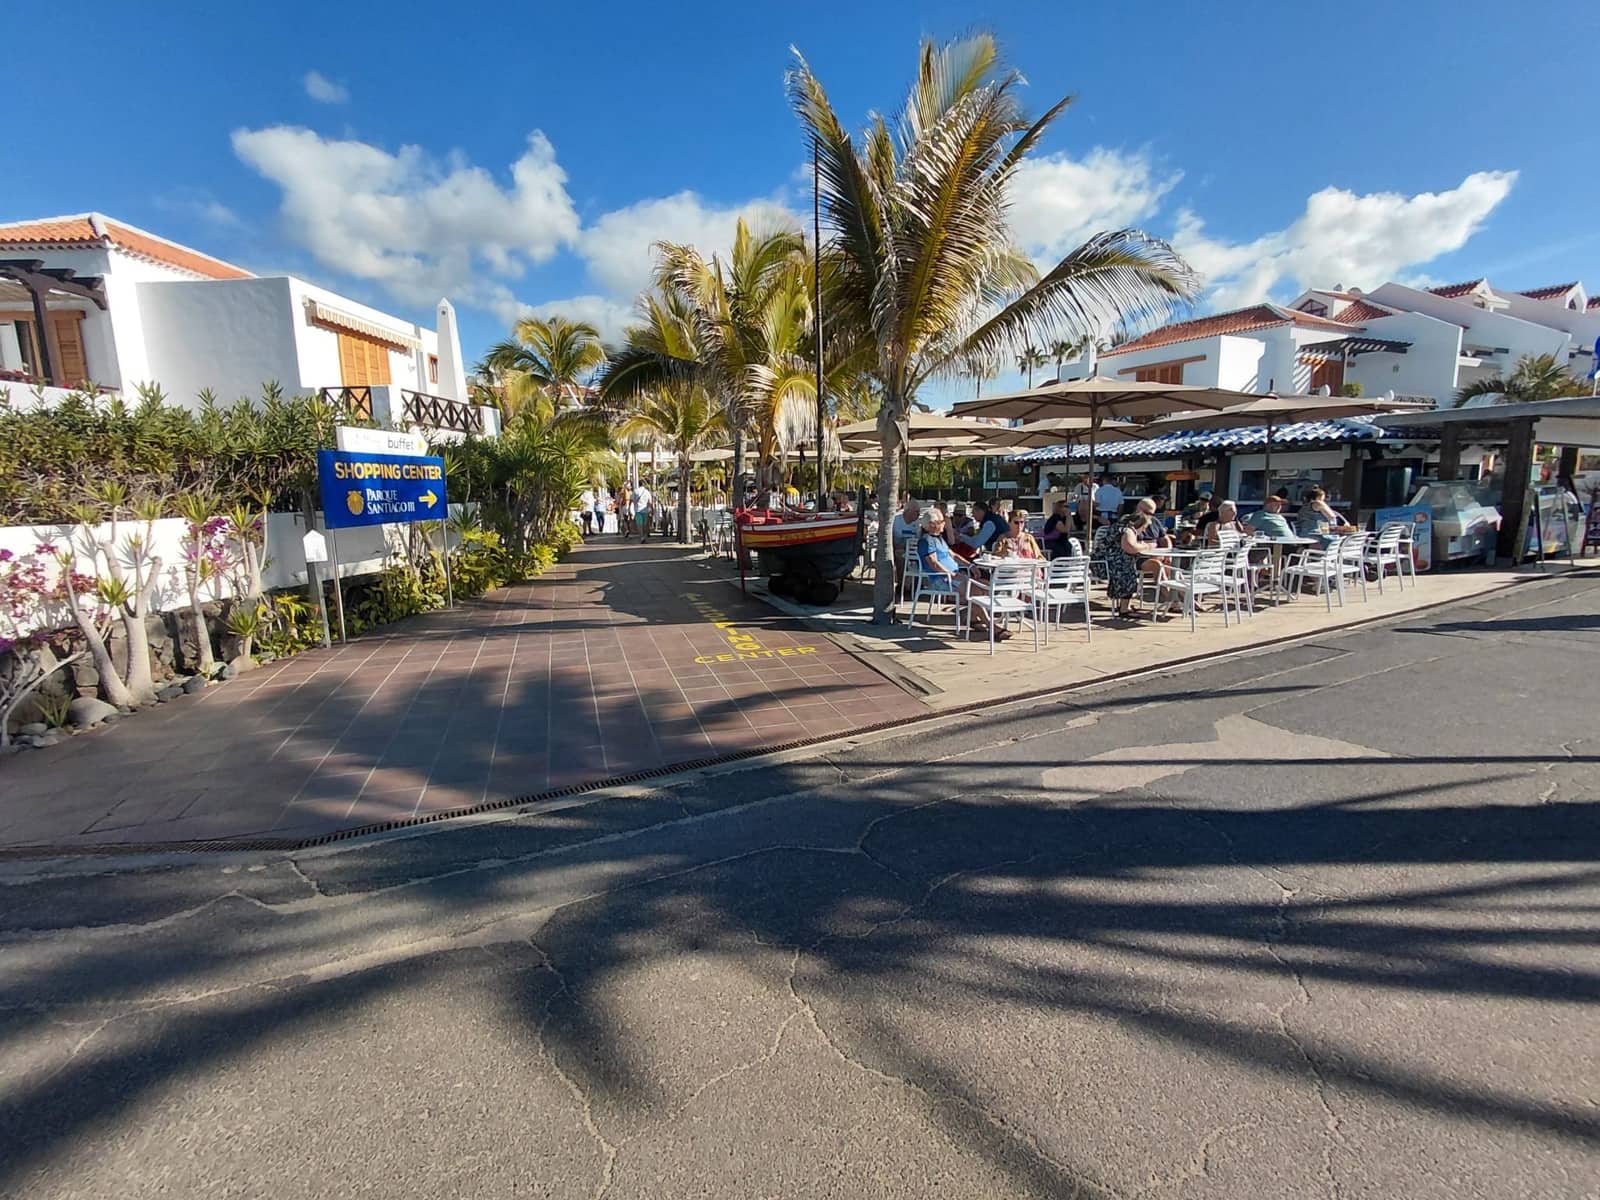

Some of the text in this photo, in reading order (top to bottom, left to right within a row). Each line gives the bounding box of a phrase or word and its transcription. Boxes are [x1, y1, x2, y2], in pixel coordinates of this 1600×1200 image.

[387, 437, 414, 450] buffet
[334, 462, 443, 480] SHOPPING CENTER
[366, 488, 398, 502] PARQUE
[367, 502, 407, 515] SANTIAGO
[694, 646, 817, 664] CENTER
